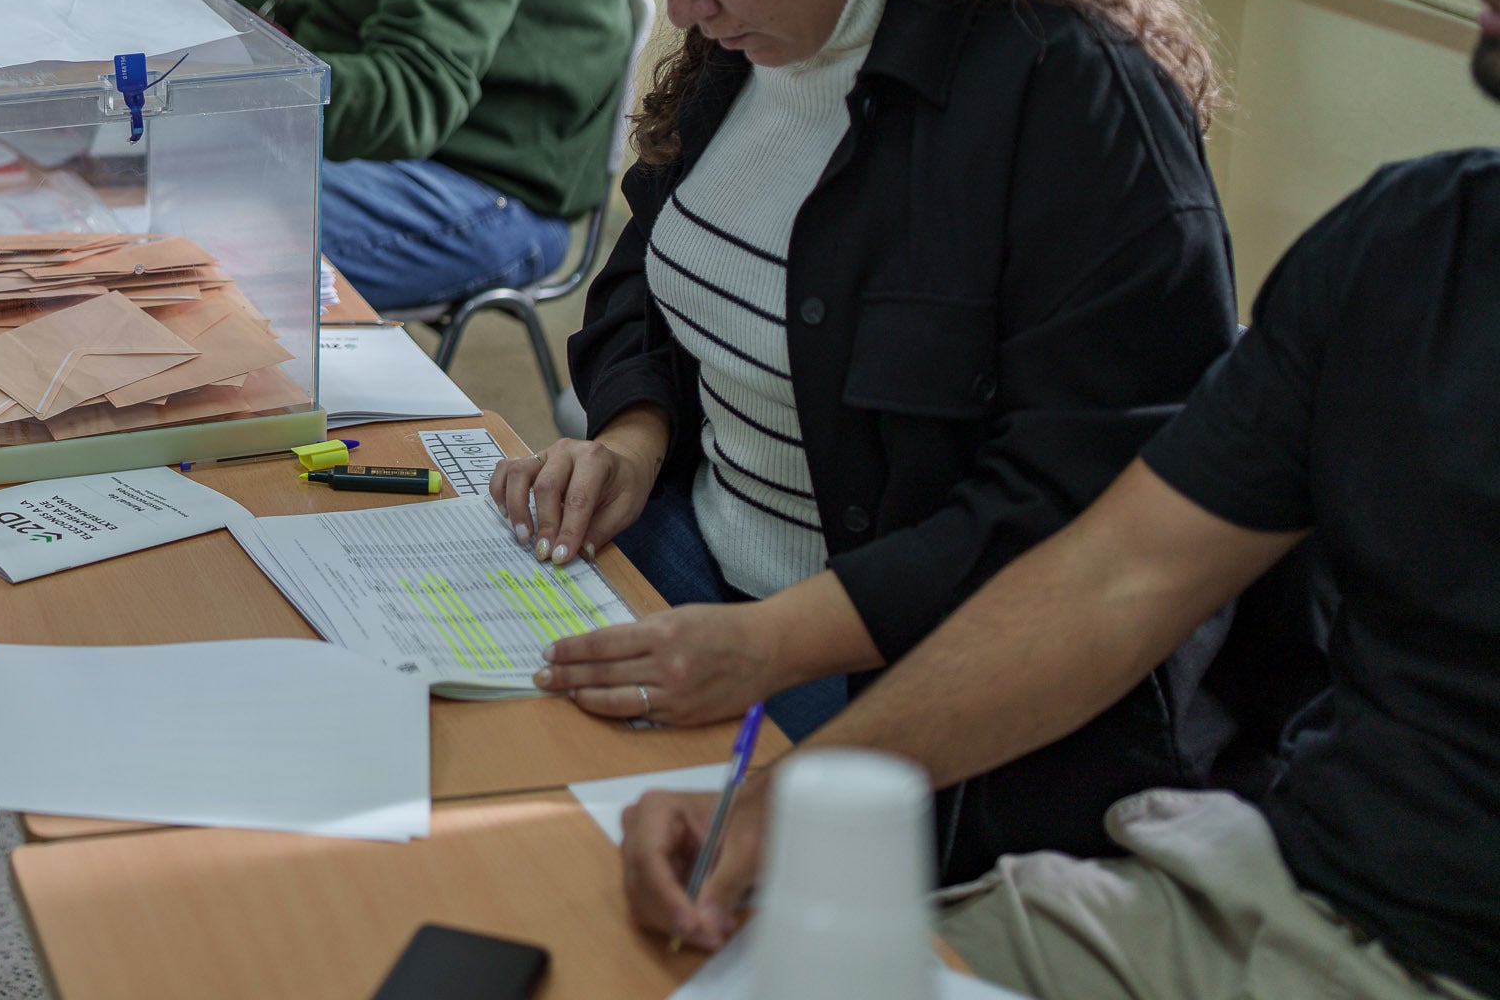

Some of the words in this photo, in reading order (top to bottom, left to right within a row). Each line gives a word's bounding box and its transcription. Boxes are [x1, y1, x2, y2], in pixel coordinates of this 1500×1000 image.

[452, 434, 475, 443] 19
[461, 446, 483, 455] 18
[470, 459, 493, 468] 17
[20, 499, 35, 509] LA
[39, 500, 55, 509] DE
[51, 494, 119, 531] EXTREMADURA
[52, 507, 102, 532] ASAMBLEA
[40, 512, 93, 541] ELECCIONES
